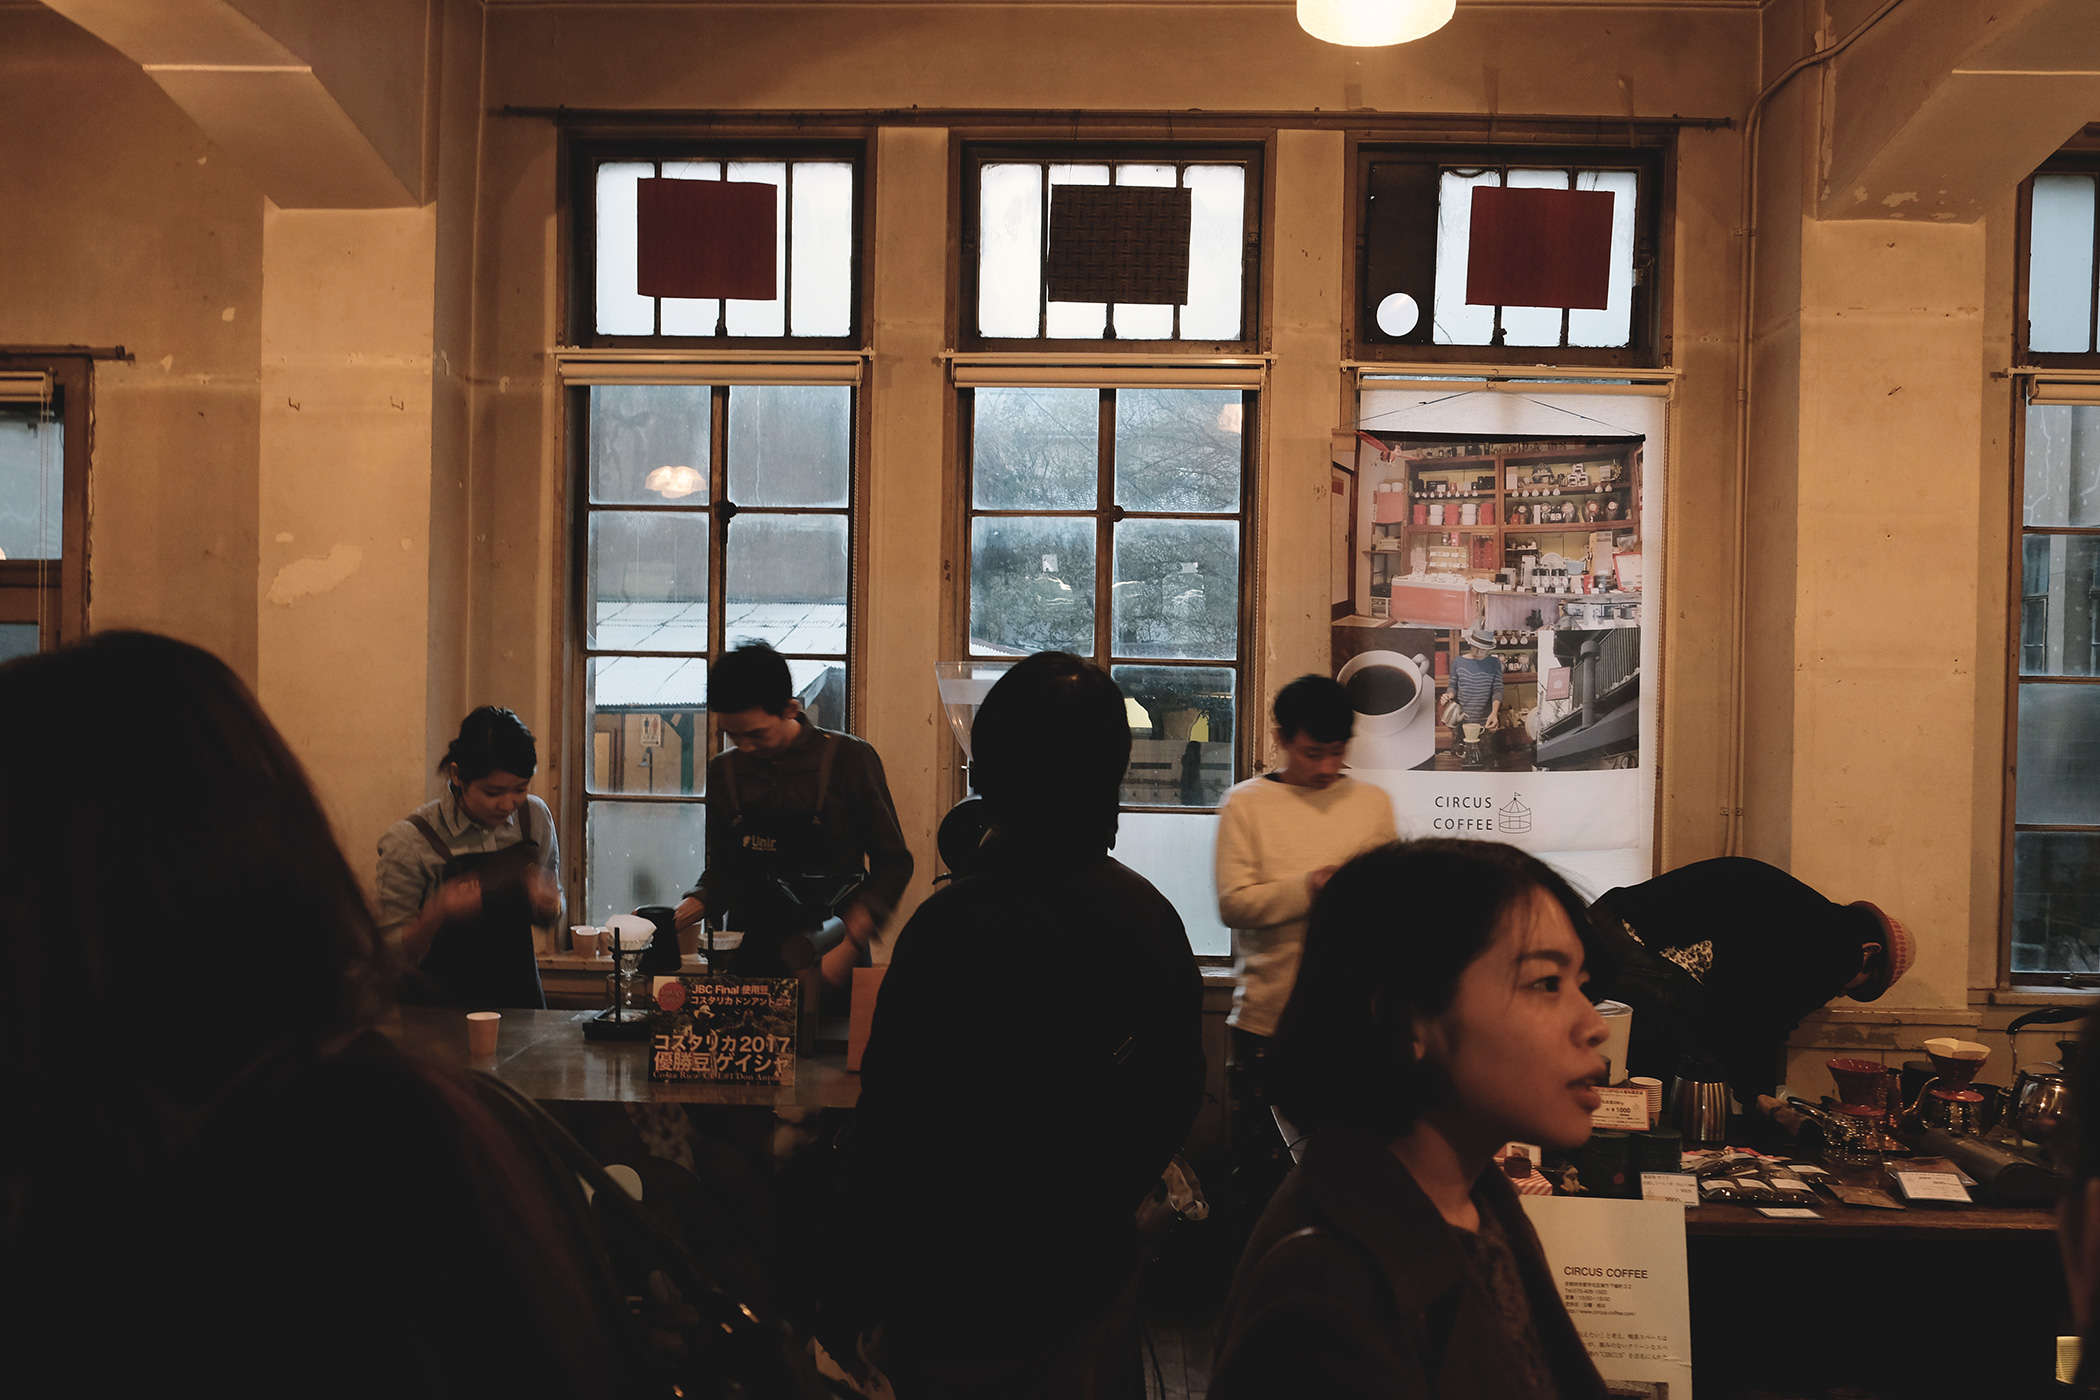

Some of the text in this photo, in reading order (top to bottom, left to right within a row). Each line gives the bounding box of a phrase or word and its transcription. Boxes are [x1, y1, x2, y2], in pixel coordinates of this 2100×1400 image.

[1434, 796, 1492, 809] CIRCUS
[1433, 818, 1493, 831] COFFEE
[692, 984, 769, 996] JBC Final 使用豆
[1564, 1266, 1648, 1279] CIRCUS COFFEE
